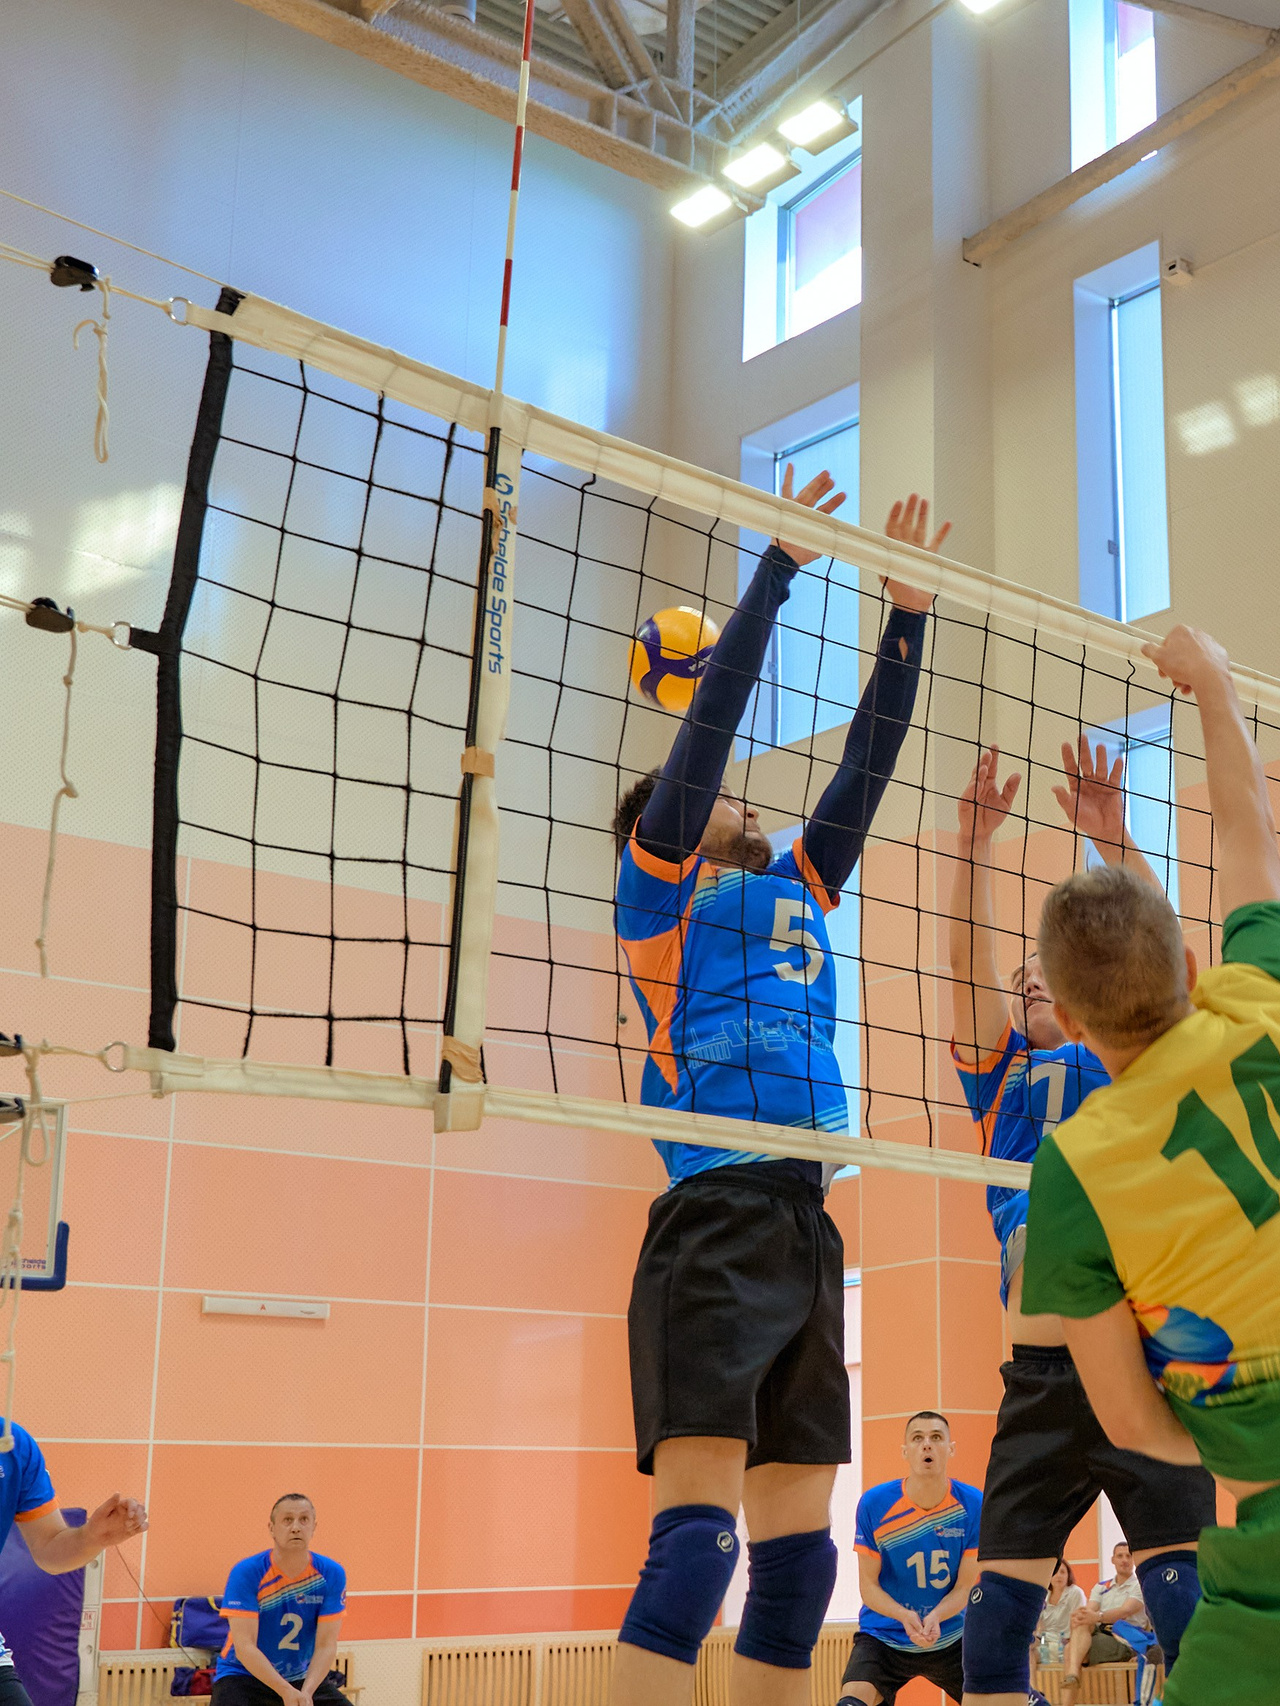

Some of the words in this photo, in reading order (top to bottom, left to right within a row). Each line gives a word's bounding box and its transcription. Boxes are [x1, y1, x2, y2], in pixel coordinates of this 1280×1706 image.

[486, 599, 508, 675] Sports
[769, 897, 825, 986] 5
[906, 1549, 951, 1590] 15
[278, 1612, 304, 1651] 2
